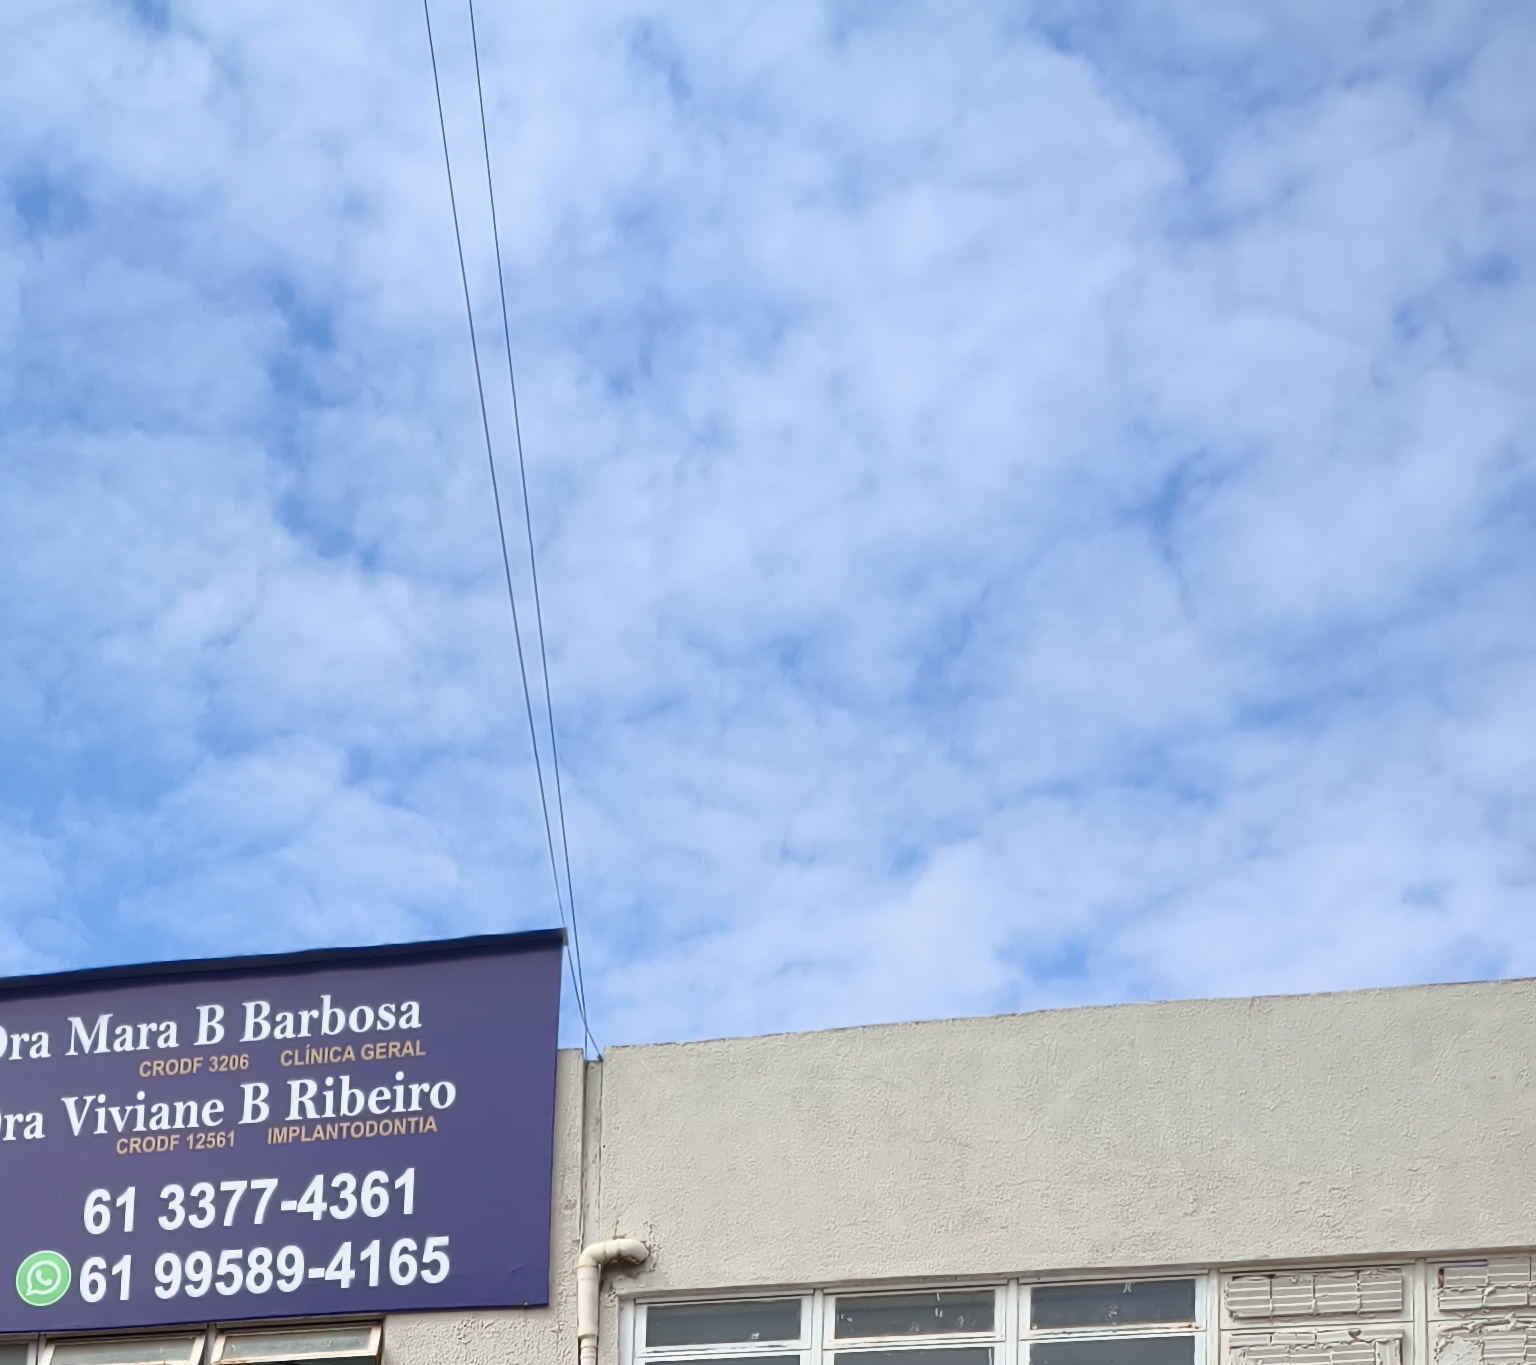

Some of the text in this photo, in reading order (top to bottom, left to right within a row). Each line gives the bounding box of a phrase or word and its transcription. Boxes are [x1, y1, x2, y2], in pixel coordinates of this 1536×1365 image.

[64, 1012, 180, 1056] Mara
[193, 1004, 226, 1047] B
[239, 994, 422, 1042] Barbosa
[138, 1039, 427, 1078] CRODF 3206 CLÍNICA GERAL
[61, 1089, 225, 1137] Viviane
[237, 1081, 271, 1126] B
[284, 1071, 457, 1121] Ribeiro
[115, 1116, 438, 1155] CRODF 12561 IMPLANTODONTIA
[82, 1167, 418, 1236] 61 3377-4361
[77, 1235, 452, 1304] 61 99589-4165
